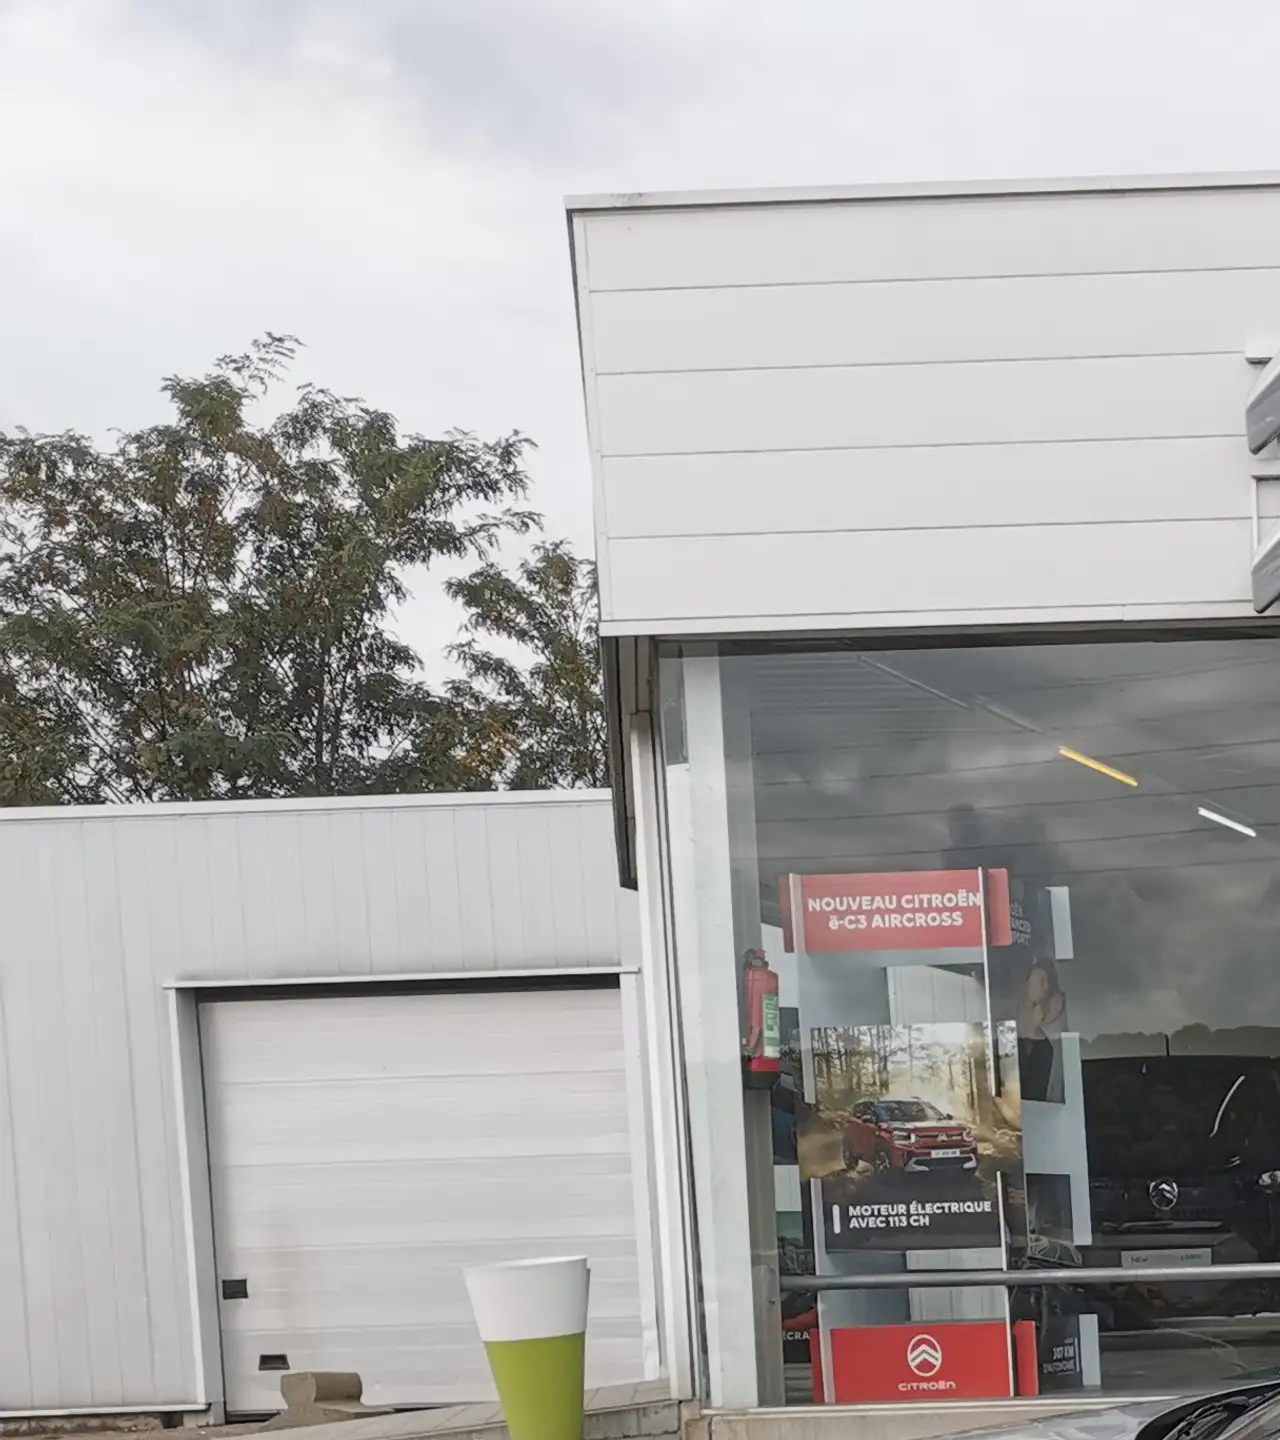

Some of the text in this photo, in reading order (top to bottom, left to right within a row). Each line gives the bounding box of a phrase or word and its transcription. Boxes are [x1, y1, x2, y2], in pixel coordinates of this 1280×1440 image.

[808, 889, 981, 913] NOUVEAU CITROËN
[829, 911, 964, 931] ë-C3 AIRCROSS
[848, 1201, 992, 1216] MOTEUR ÉLECTRIQUE
[849, 1214, 930, 1229] AVEC 113 CH
